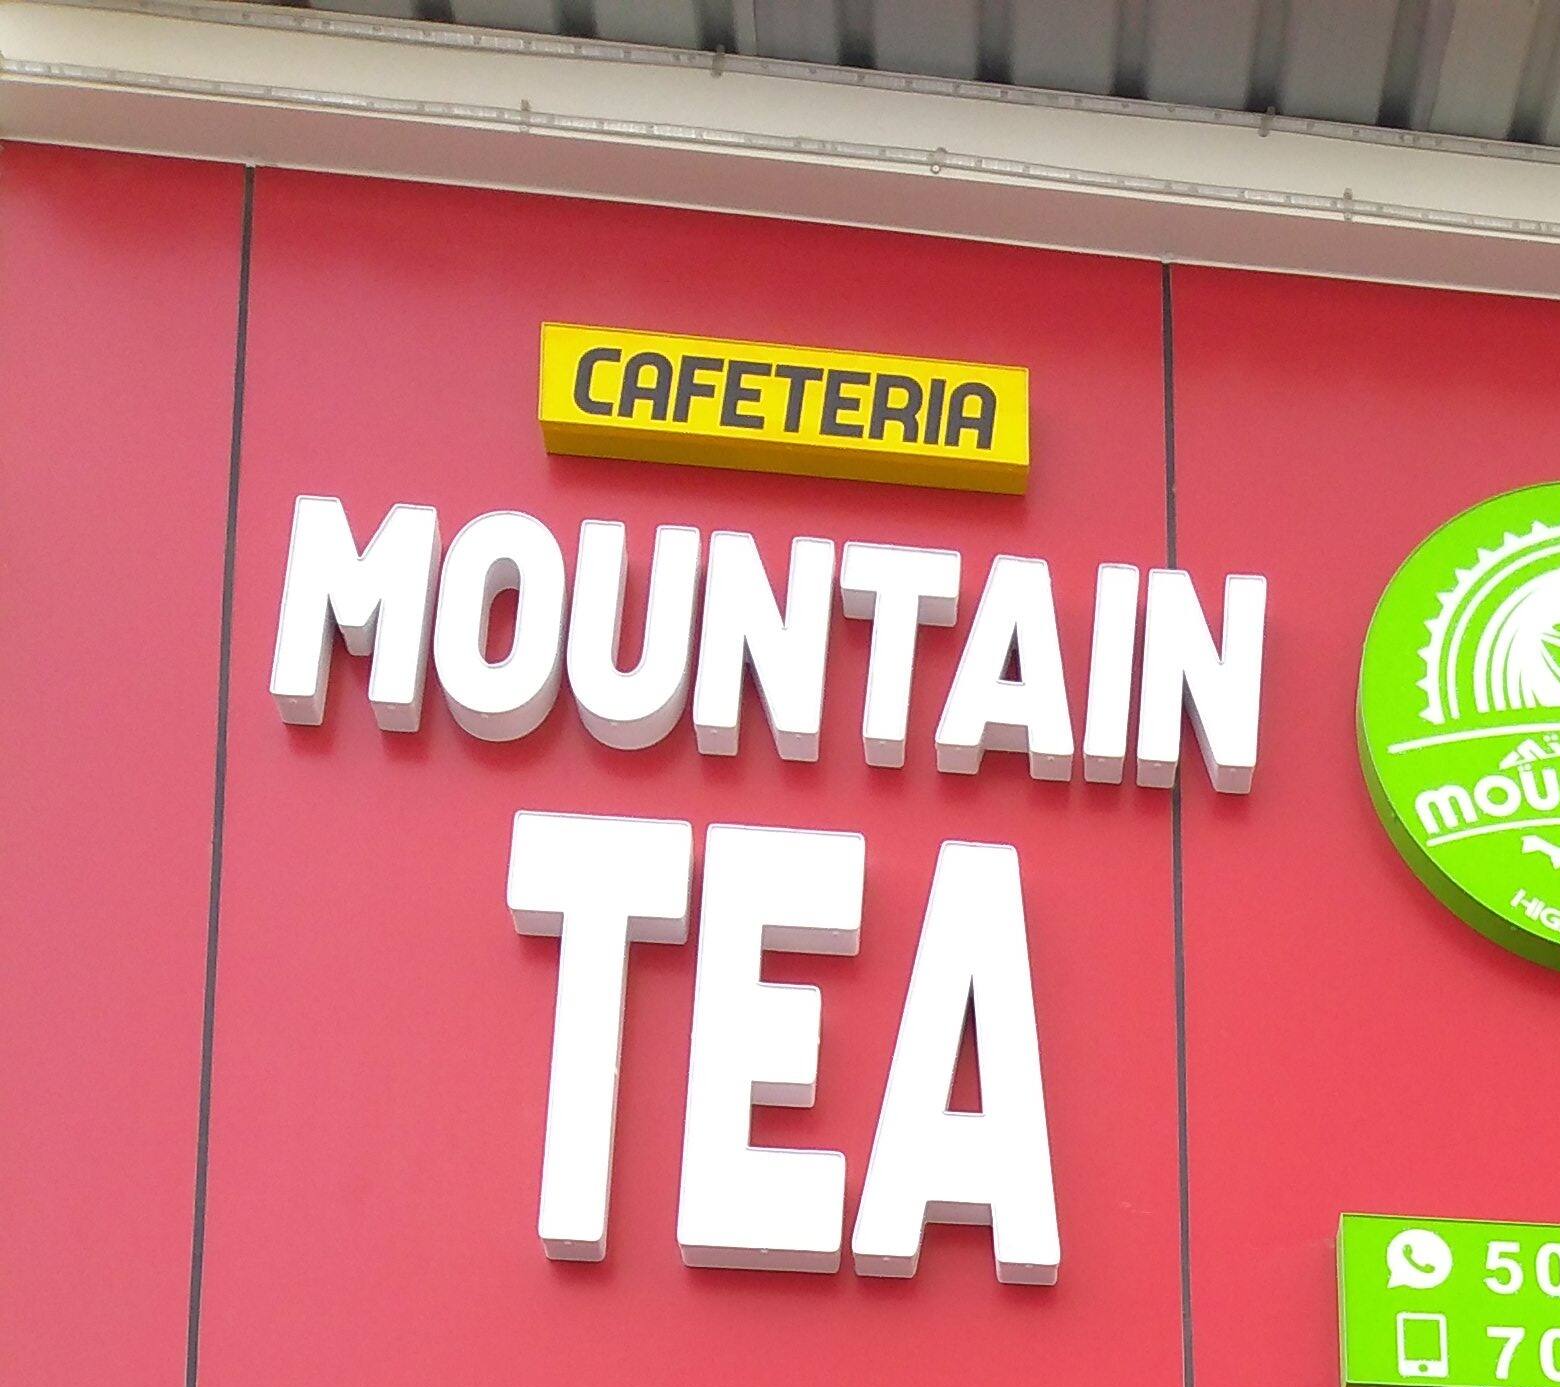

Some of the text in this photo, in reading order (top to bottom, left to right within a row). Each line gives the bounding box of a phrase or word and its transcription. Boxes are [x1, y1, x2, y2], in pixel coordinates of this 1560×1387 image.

[572, 347, 997, 449] CAFETERIA
[269, 495, 1266, 792] MOUNTAIN
[507, 810, 1060, 1284] TEA
